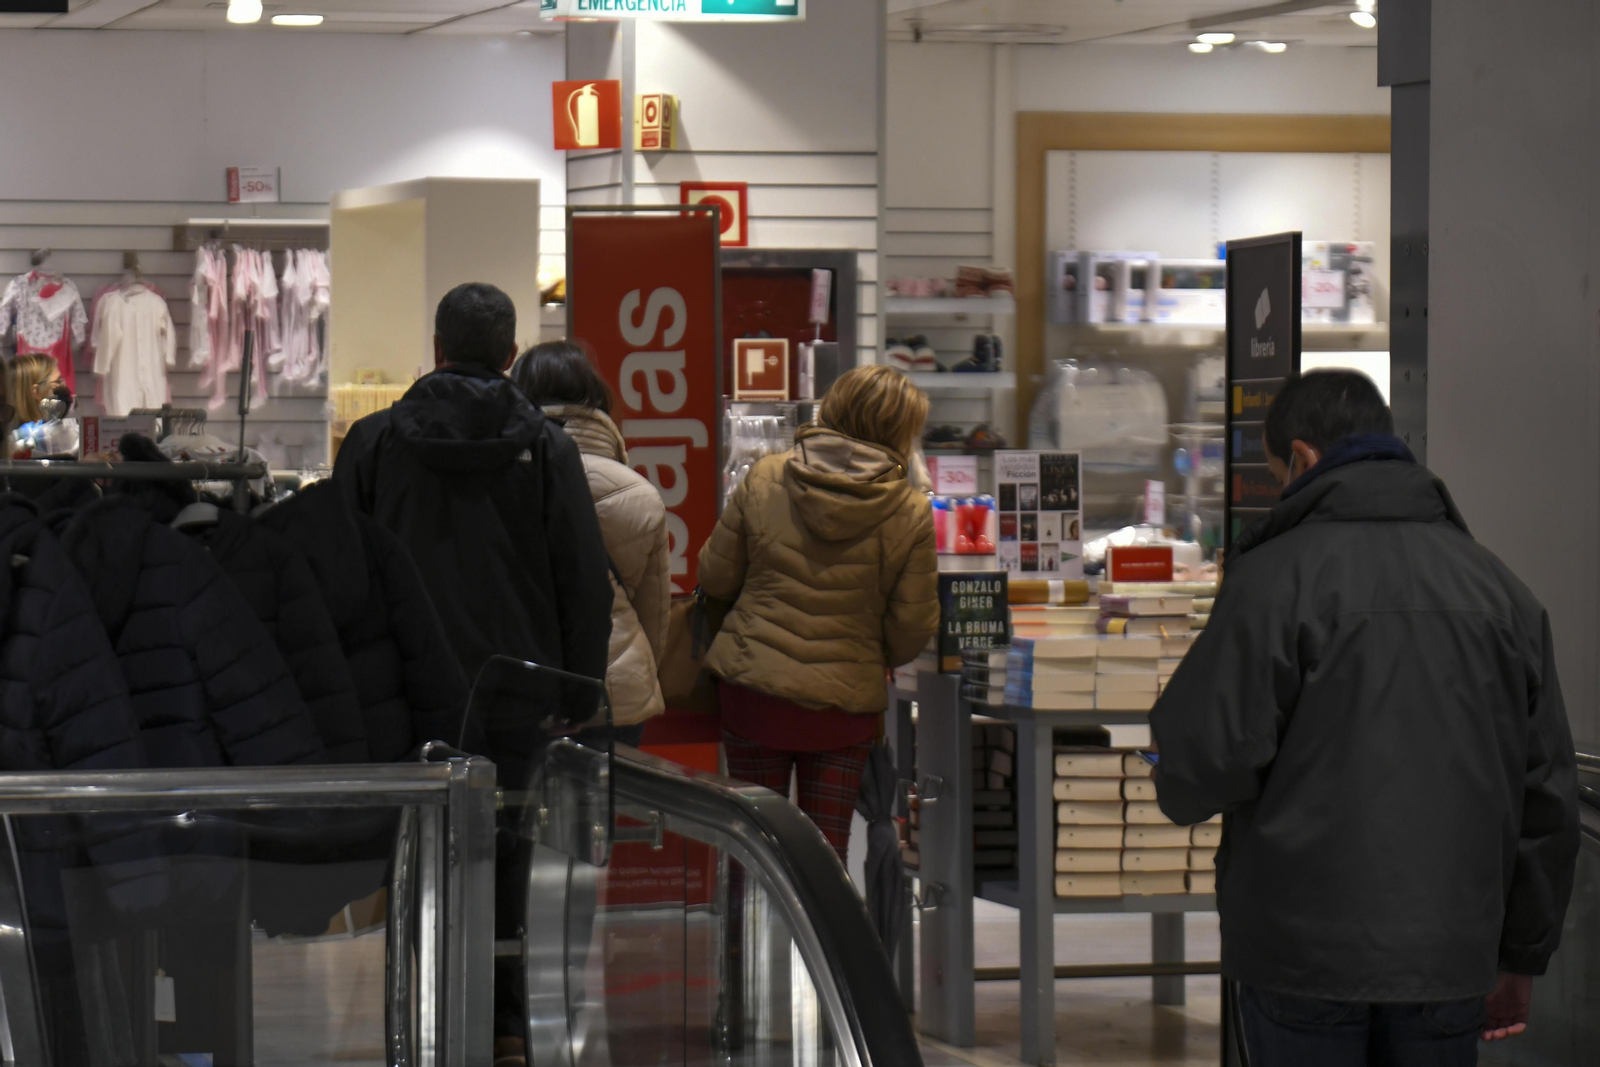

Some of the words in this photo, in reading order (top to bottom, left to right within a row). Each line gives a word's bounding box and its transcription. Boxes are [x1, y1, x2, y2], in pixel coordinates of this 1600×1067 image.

[242, 180, 273, 192] -50%
[951, 581, 1001, 593] GONZALO
[960, 596, 993, 608] GINER
[948, 621, 961, 634] LA
[966, 621, 1004, 634] BRUMA
